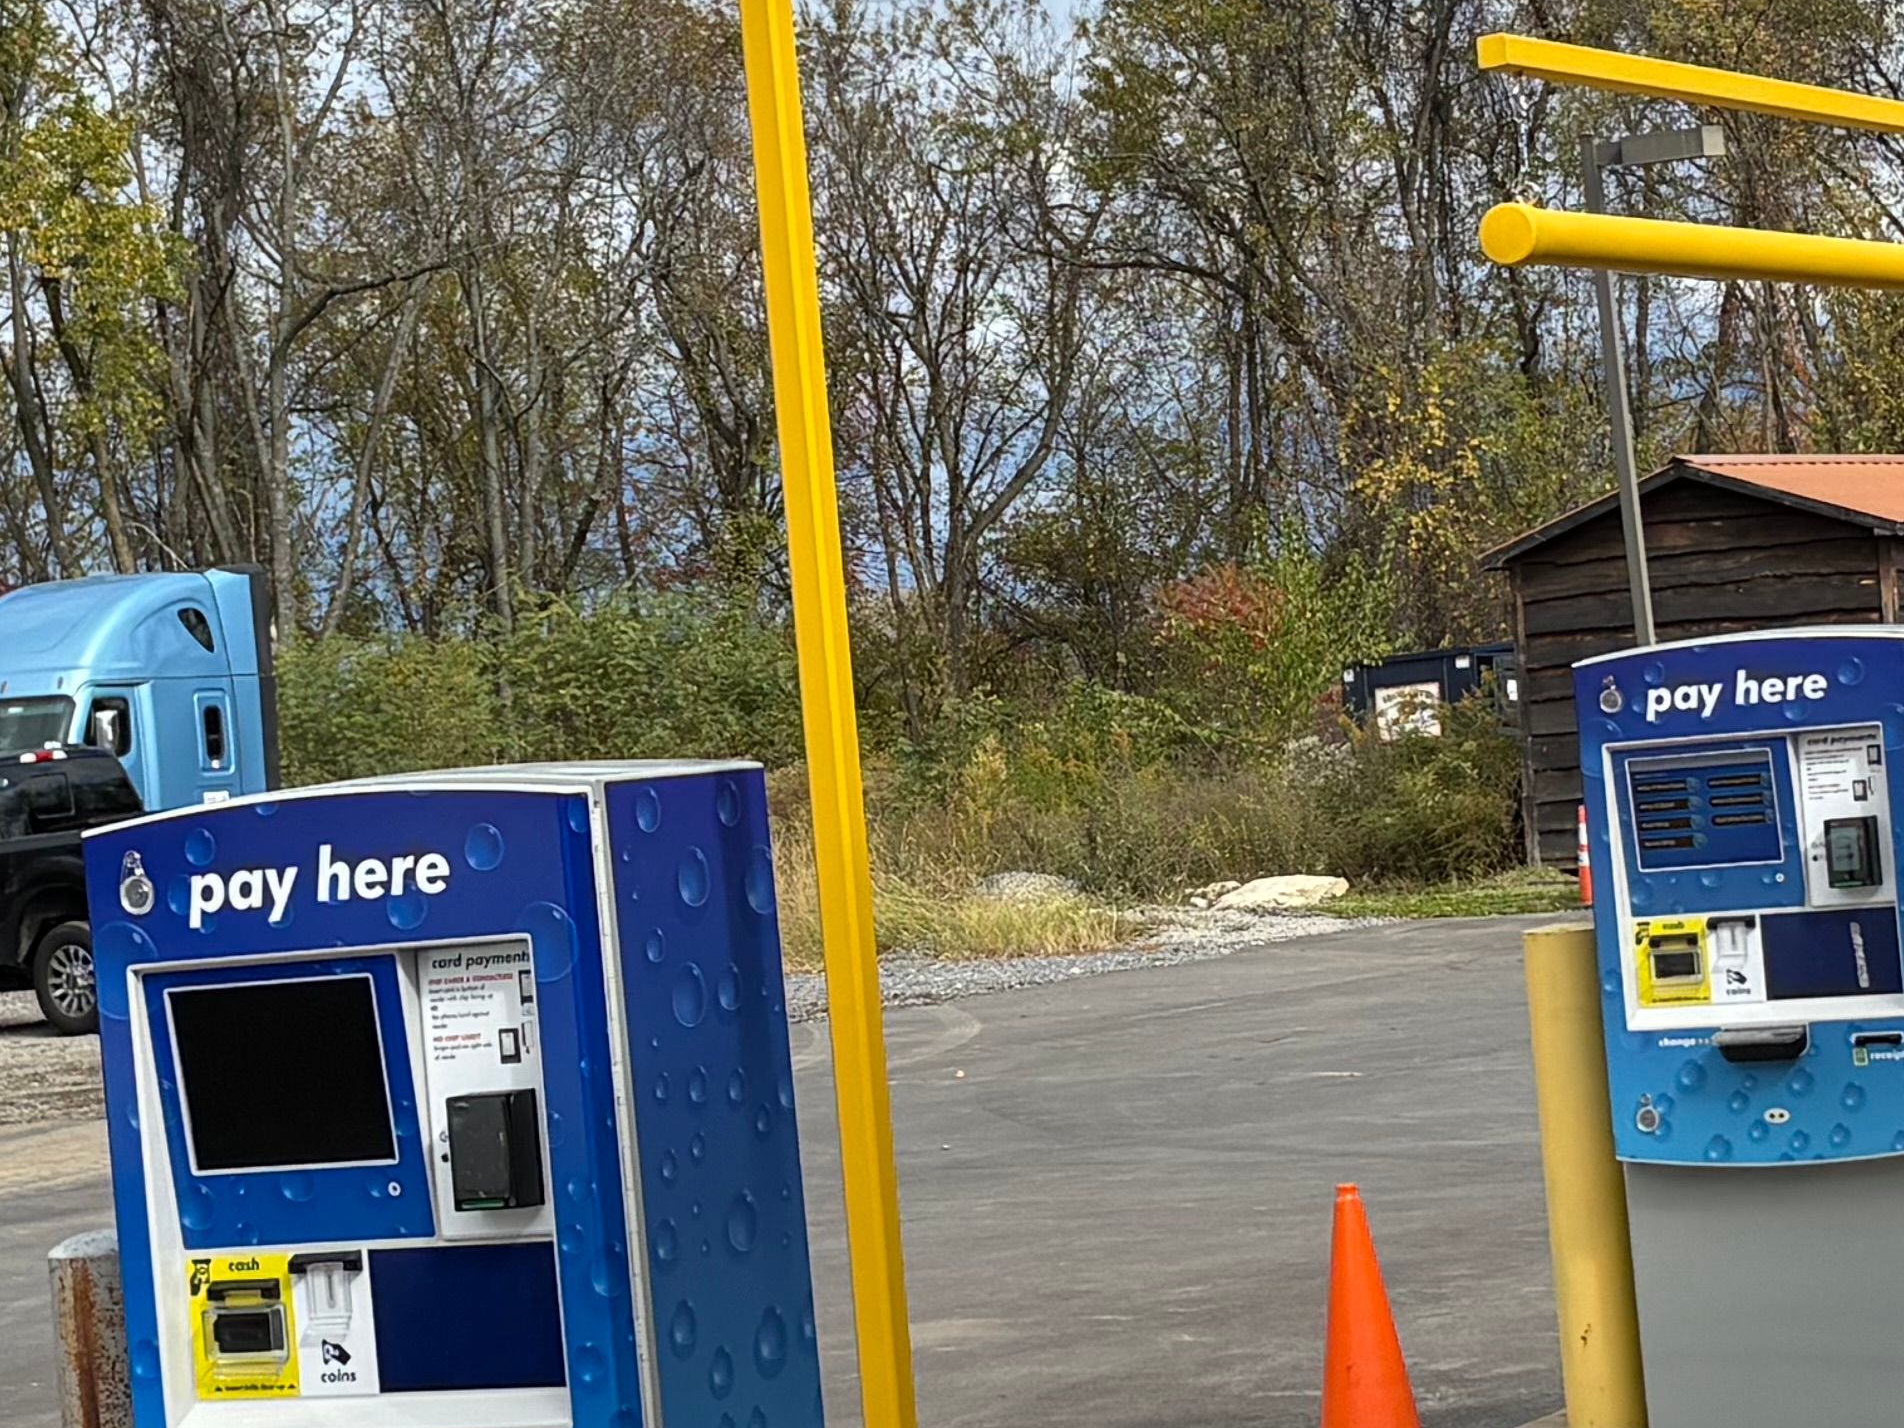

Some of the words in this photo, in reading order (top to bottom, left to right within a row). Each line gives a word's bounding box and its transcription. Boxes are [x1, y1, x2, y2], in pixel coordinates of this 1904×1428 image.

[1646, 683, 1723, 722] pay
[1735, 669, 1828, 705] here
[189, 866, 298, 929] pay
[317, 844, 450, 902] here
[432, 953, 462, 969] card
[1658, 1037, 1696, 1048] change
[228, 1258, 260, 1272] cash
[321, 1369, 357, 1384] coins
